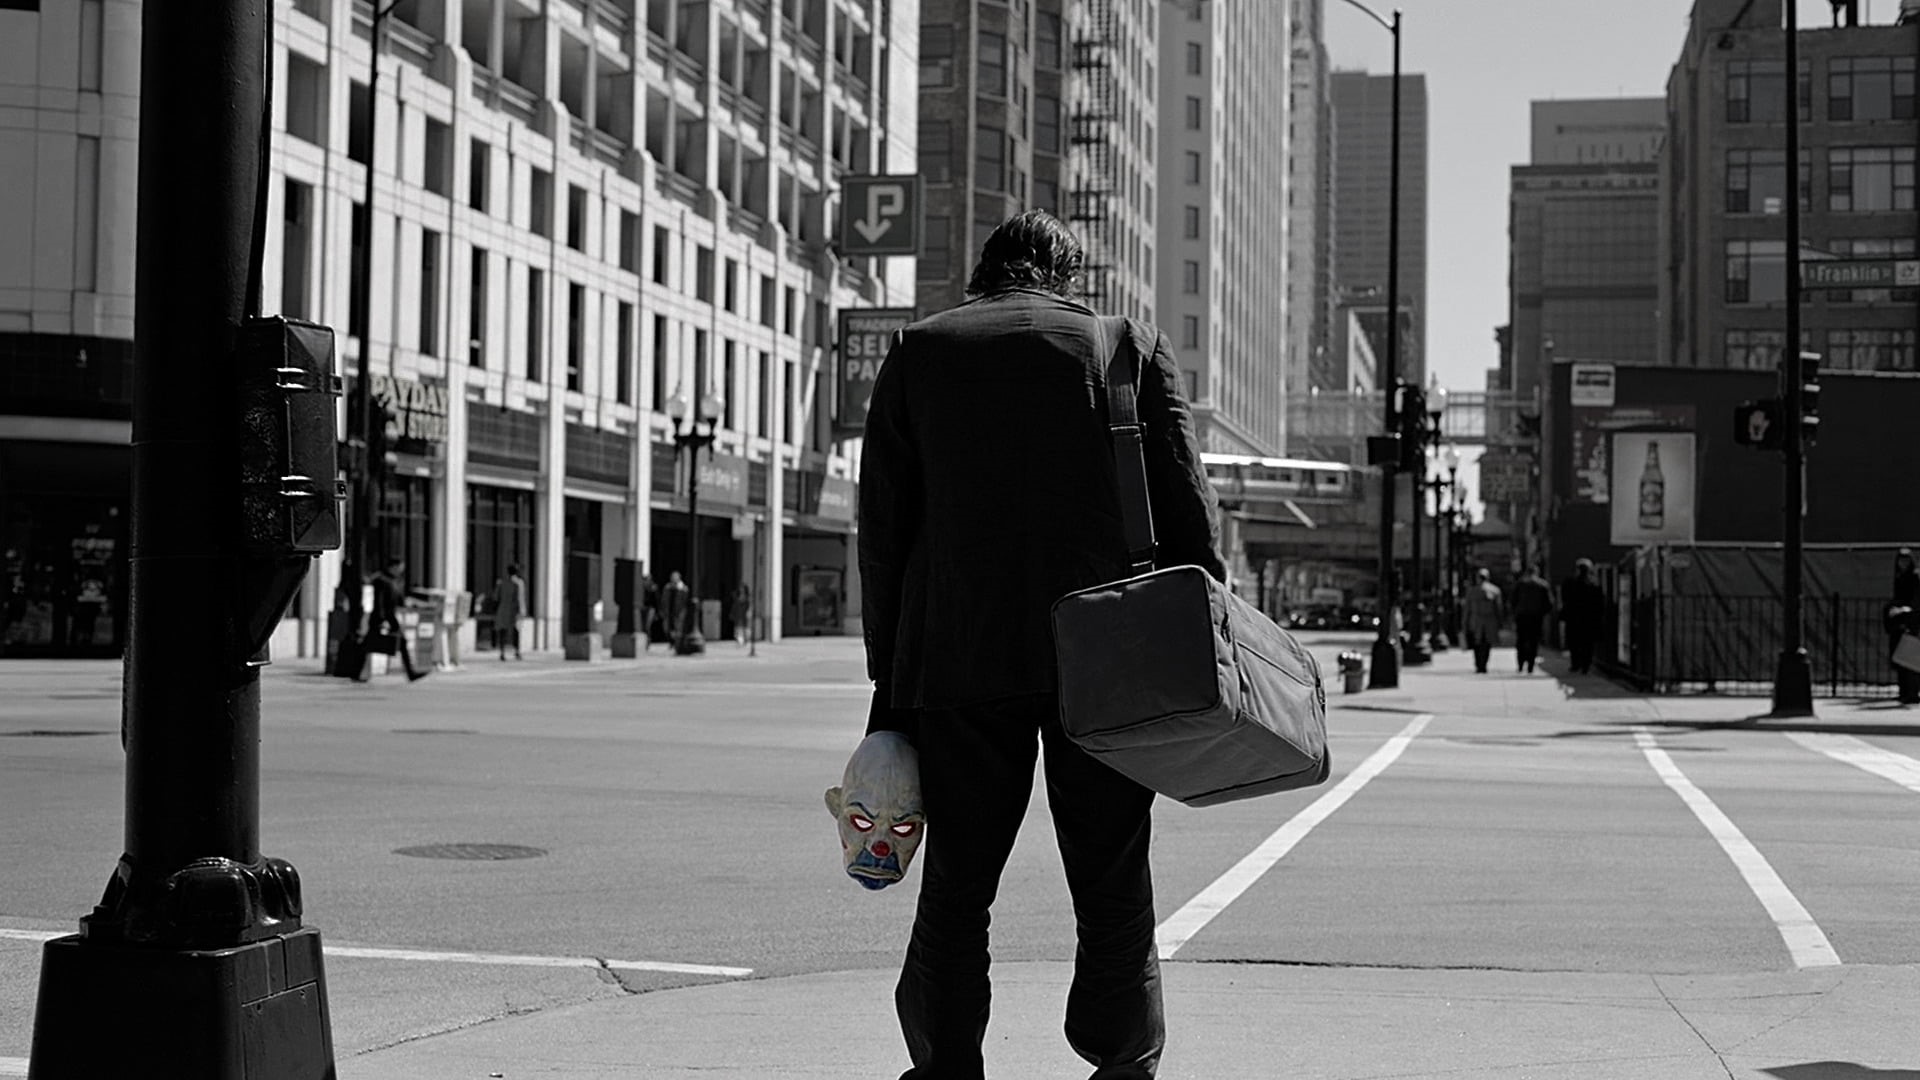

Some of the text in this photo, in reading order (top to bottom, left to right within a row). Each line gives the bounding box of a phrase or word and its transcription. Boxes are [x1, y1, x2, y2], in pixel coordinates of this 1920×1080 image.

[1816, 264, 1880, 282] Franklin
[847, 334, 889, 357] SEL
[846, 359, 880, 381] PA
[370, 376, 448, 416] PAYDAY
